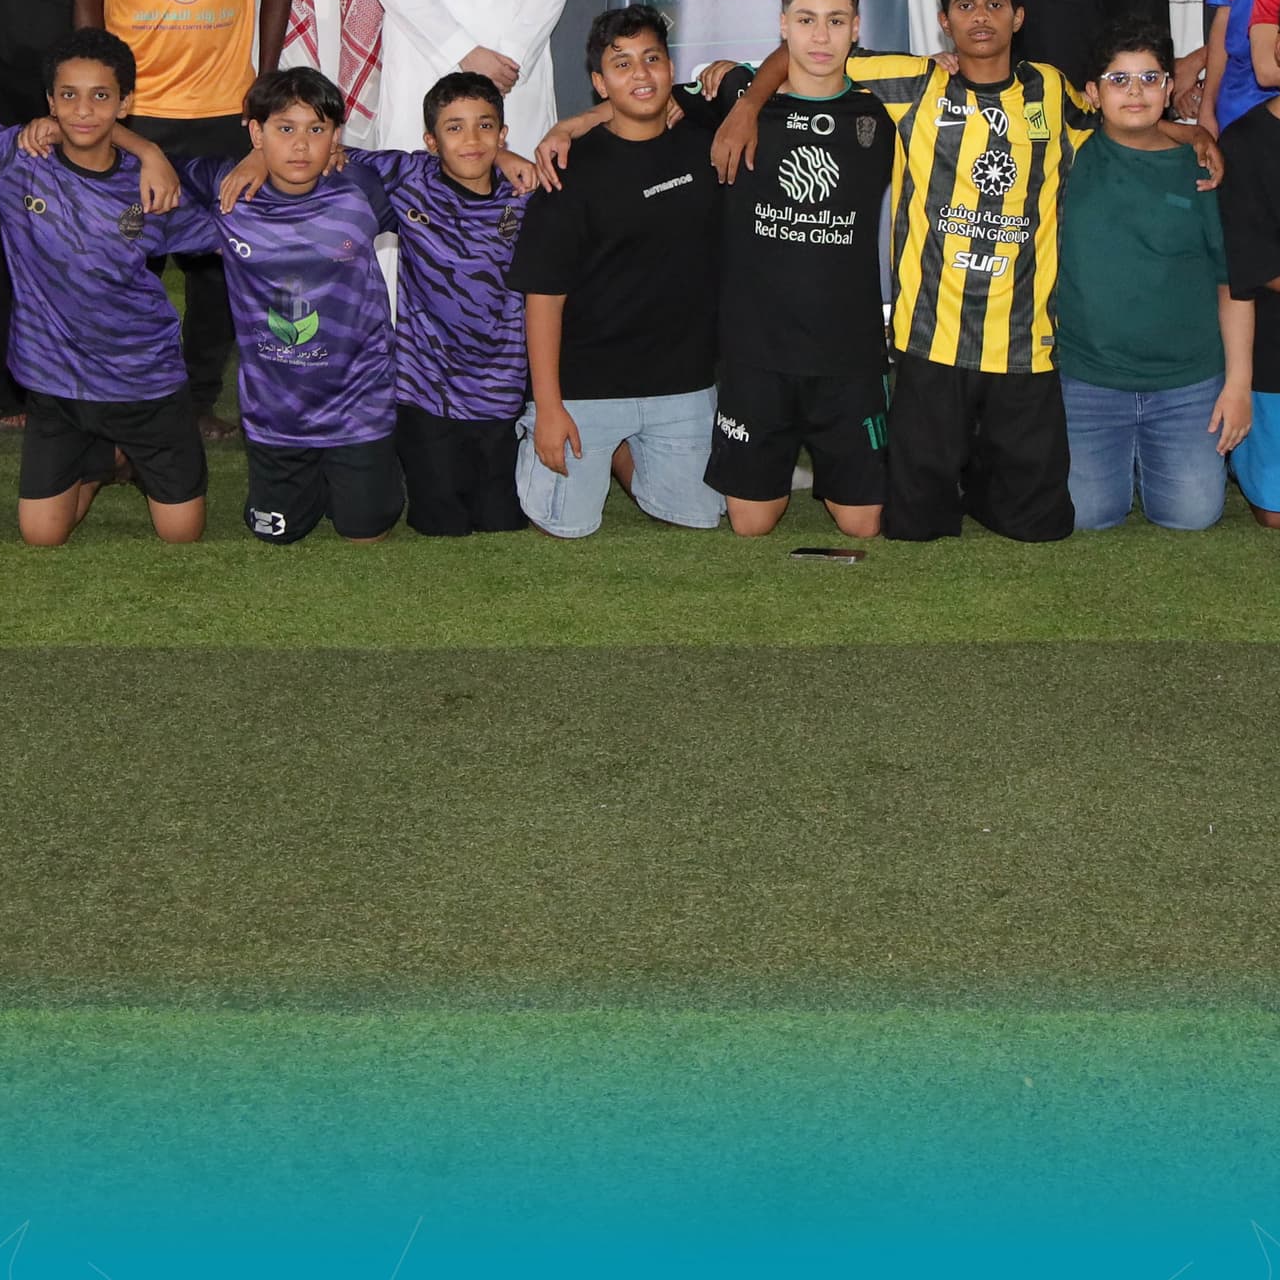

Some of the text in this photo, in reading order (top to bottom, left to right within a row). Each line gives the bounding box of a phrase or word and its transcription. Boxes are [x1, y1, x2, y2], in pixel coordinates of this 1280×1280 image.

[937, 97, 976, 116] Flow
[754, 202, 793, 222] الدولية
[829, 211, 856, 227] البحر
[939, 203, 1030, 228] مجموعة روشن
[755, 220, 853, 245] Red Sea Global
[937, 219, 1030, 244] ROSHN GROUP
